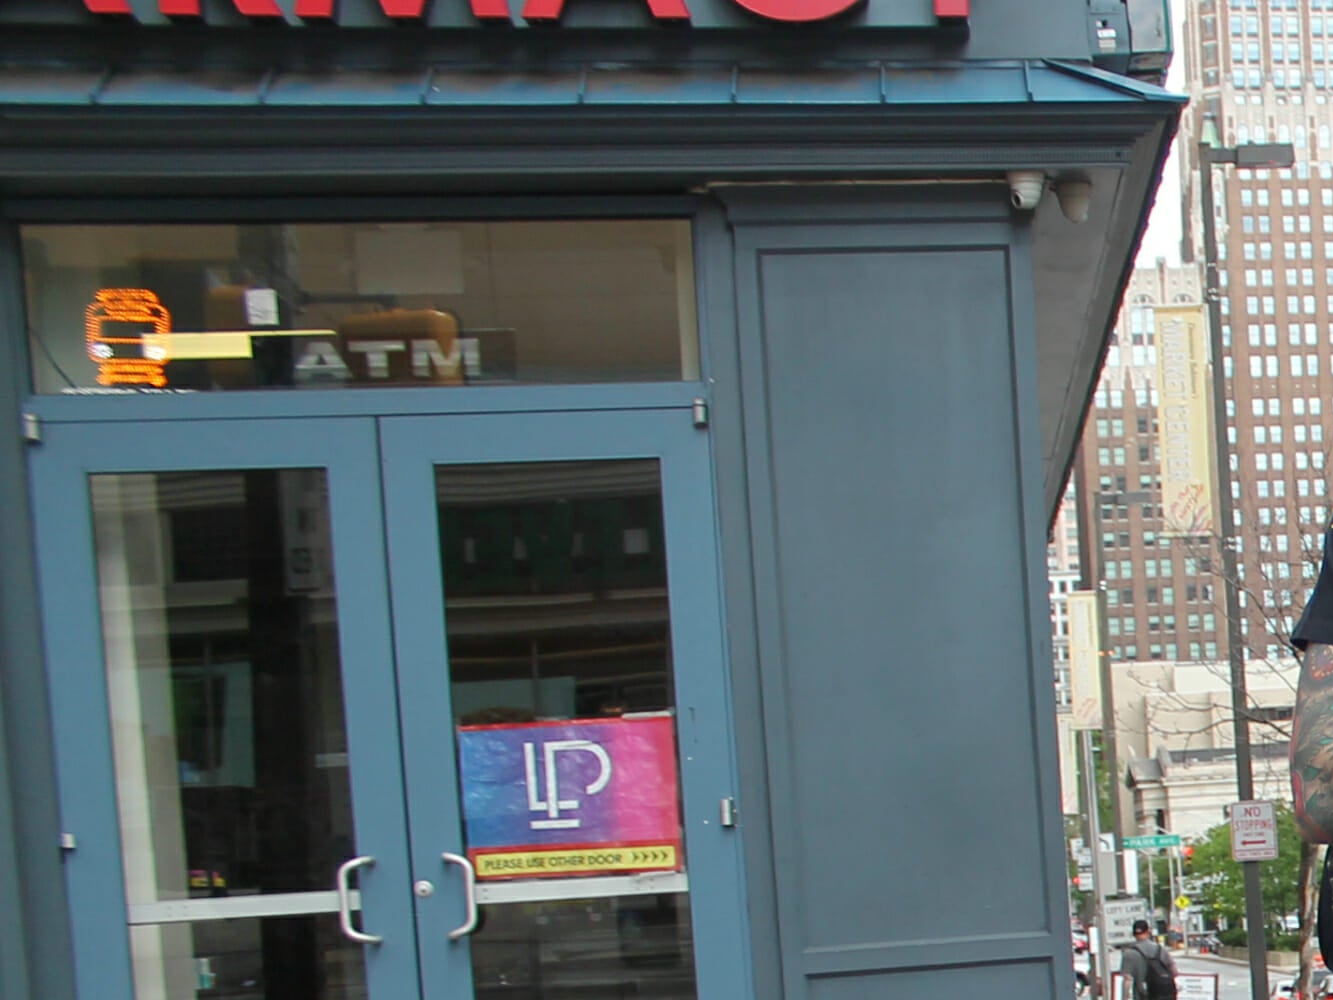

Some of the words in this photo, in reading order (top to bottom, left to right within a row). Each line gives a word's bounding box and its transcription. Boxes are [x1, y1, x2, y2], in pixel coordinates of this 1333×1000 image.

[295, 337, 482, 380] ATM
[1244, 806, 1261, 817] NO
[484, 857, 525, 871] PLEASE
[526, 856, 546, 869] USE
[549, 854, 586, 867] OTHER
[588, 853, 623, 866] DOOR
